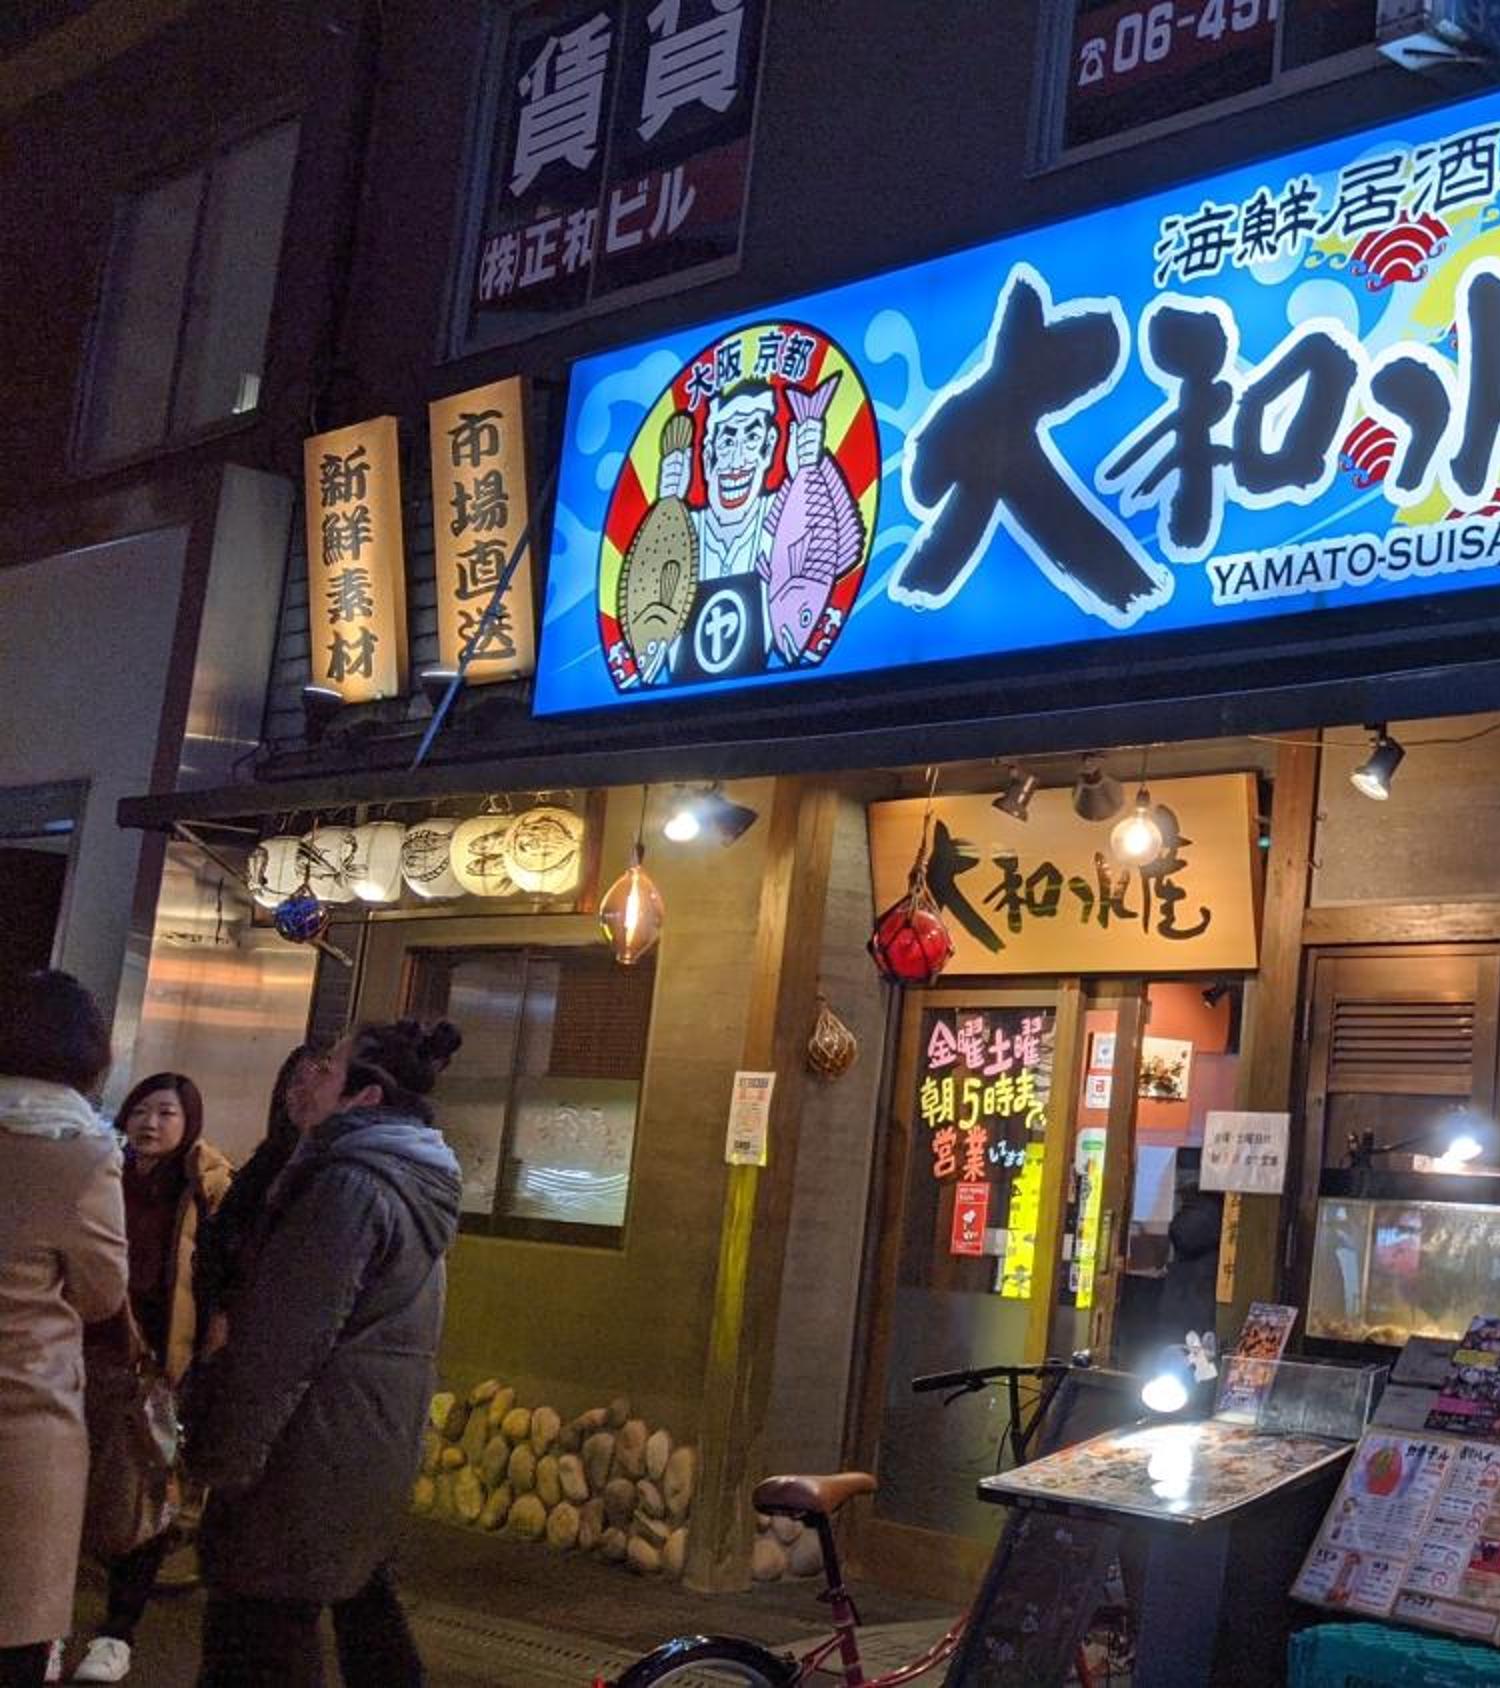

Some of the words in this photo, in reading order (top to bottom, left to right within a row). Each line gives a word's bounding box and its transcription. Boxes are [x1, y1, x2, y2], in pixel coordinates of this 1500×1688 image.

[687, 339, 742, 408] 大阪
[755, 332, 815, 380] 京都
[319, 446, 378, 682] 新鮮素材
[448, 409, 516, 663] 市場直送
[927, 1016, 1043, 1076] 金曜土曜
